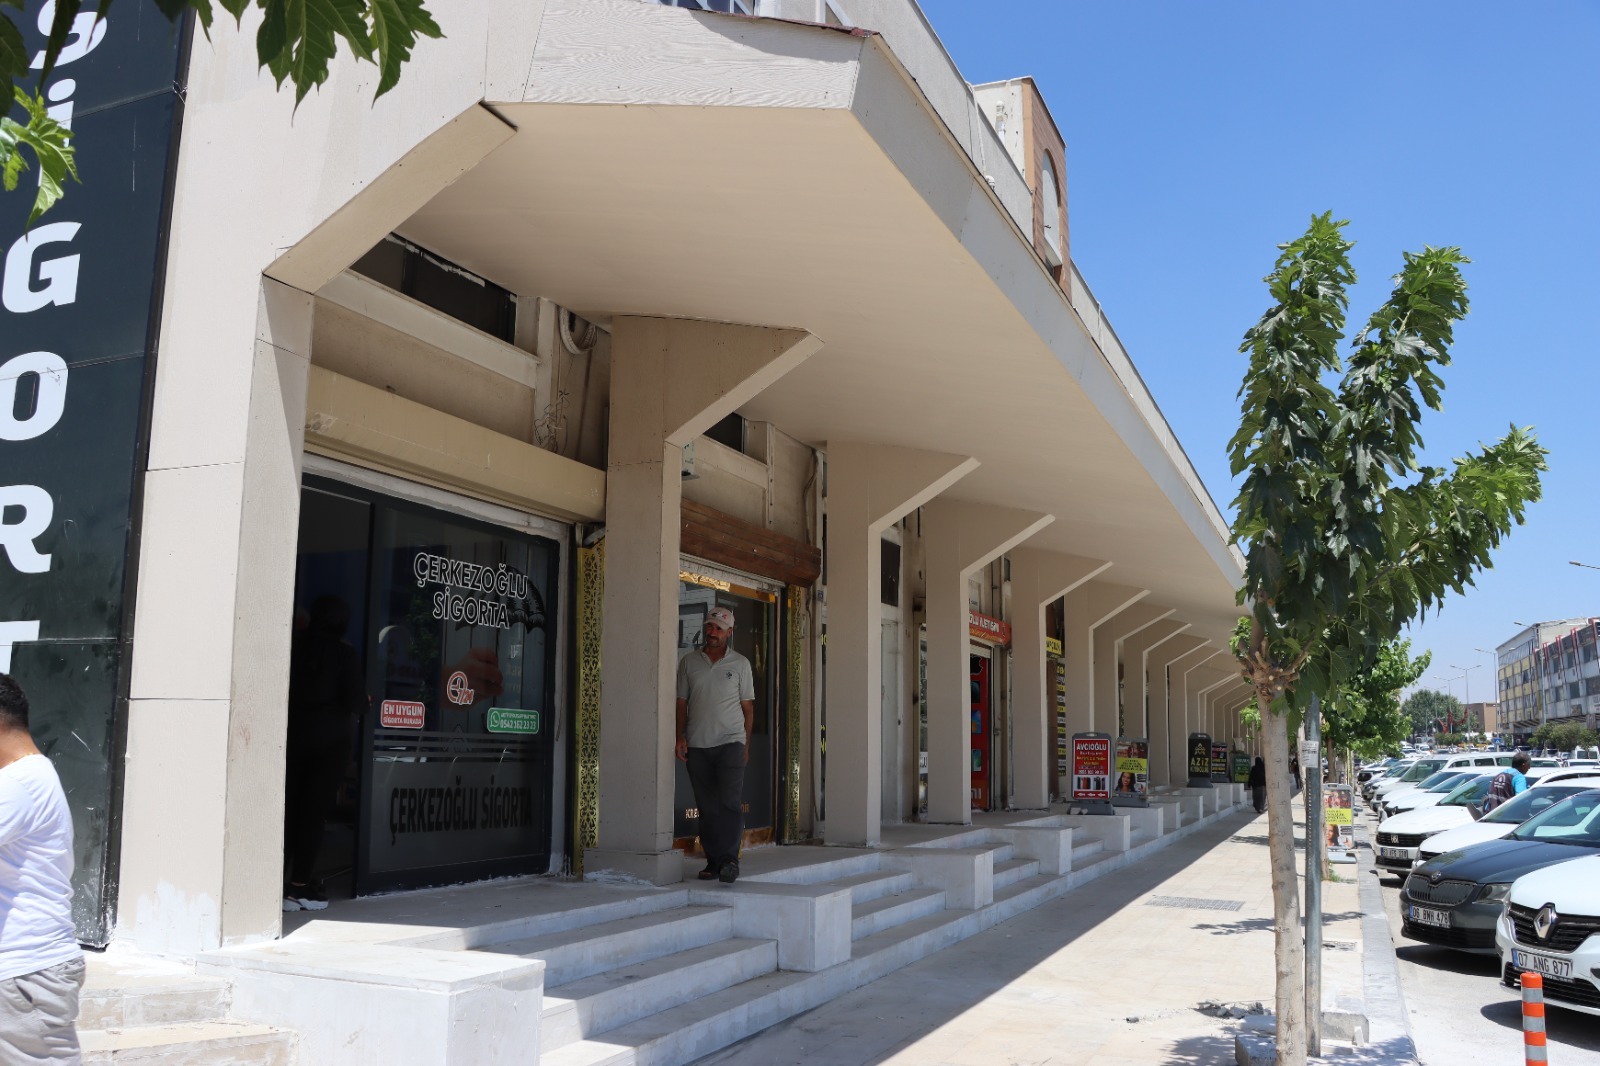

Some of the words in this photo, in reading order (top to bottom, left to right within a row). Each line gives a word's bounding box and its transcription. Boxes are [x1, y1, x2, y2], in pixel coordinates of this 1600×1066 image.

[413, 551, 528, 600] ÇERKEZOĞLU
[432, 586, 510, 630] SİGORTA
[383, 703, 394, 715] EN
[396, 704, 423, 716] UYGUN
[383, 715, 403, 724] SİGORTA
[499, 719, 513, 729] 0542
[1076, 742, 1107, 751] AVCIOĞLU
[390, 775, 478, 846] ÇERKEZOĞLU
[480, 774, 532, 829] SİGORTA
[1518, 953, 1527, 966] 07
[1533, 956, 1549, 972] ANG
[1552, 960, 1569, 976] 877
